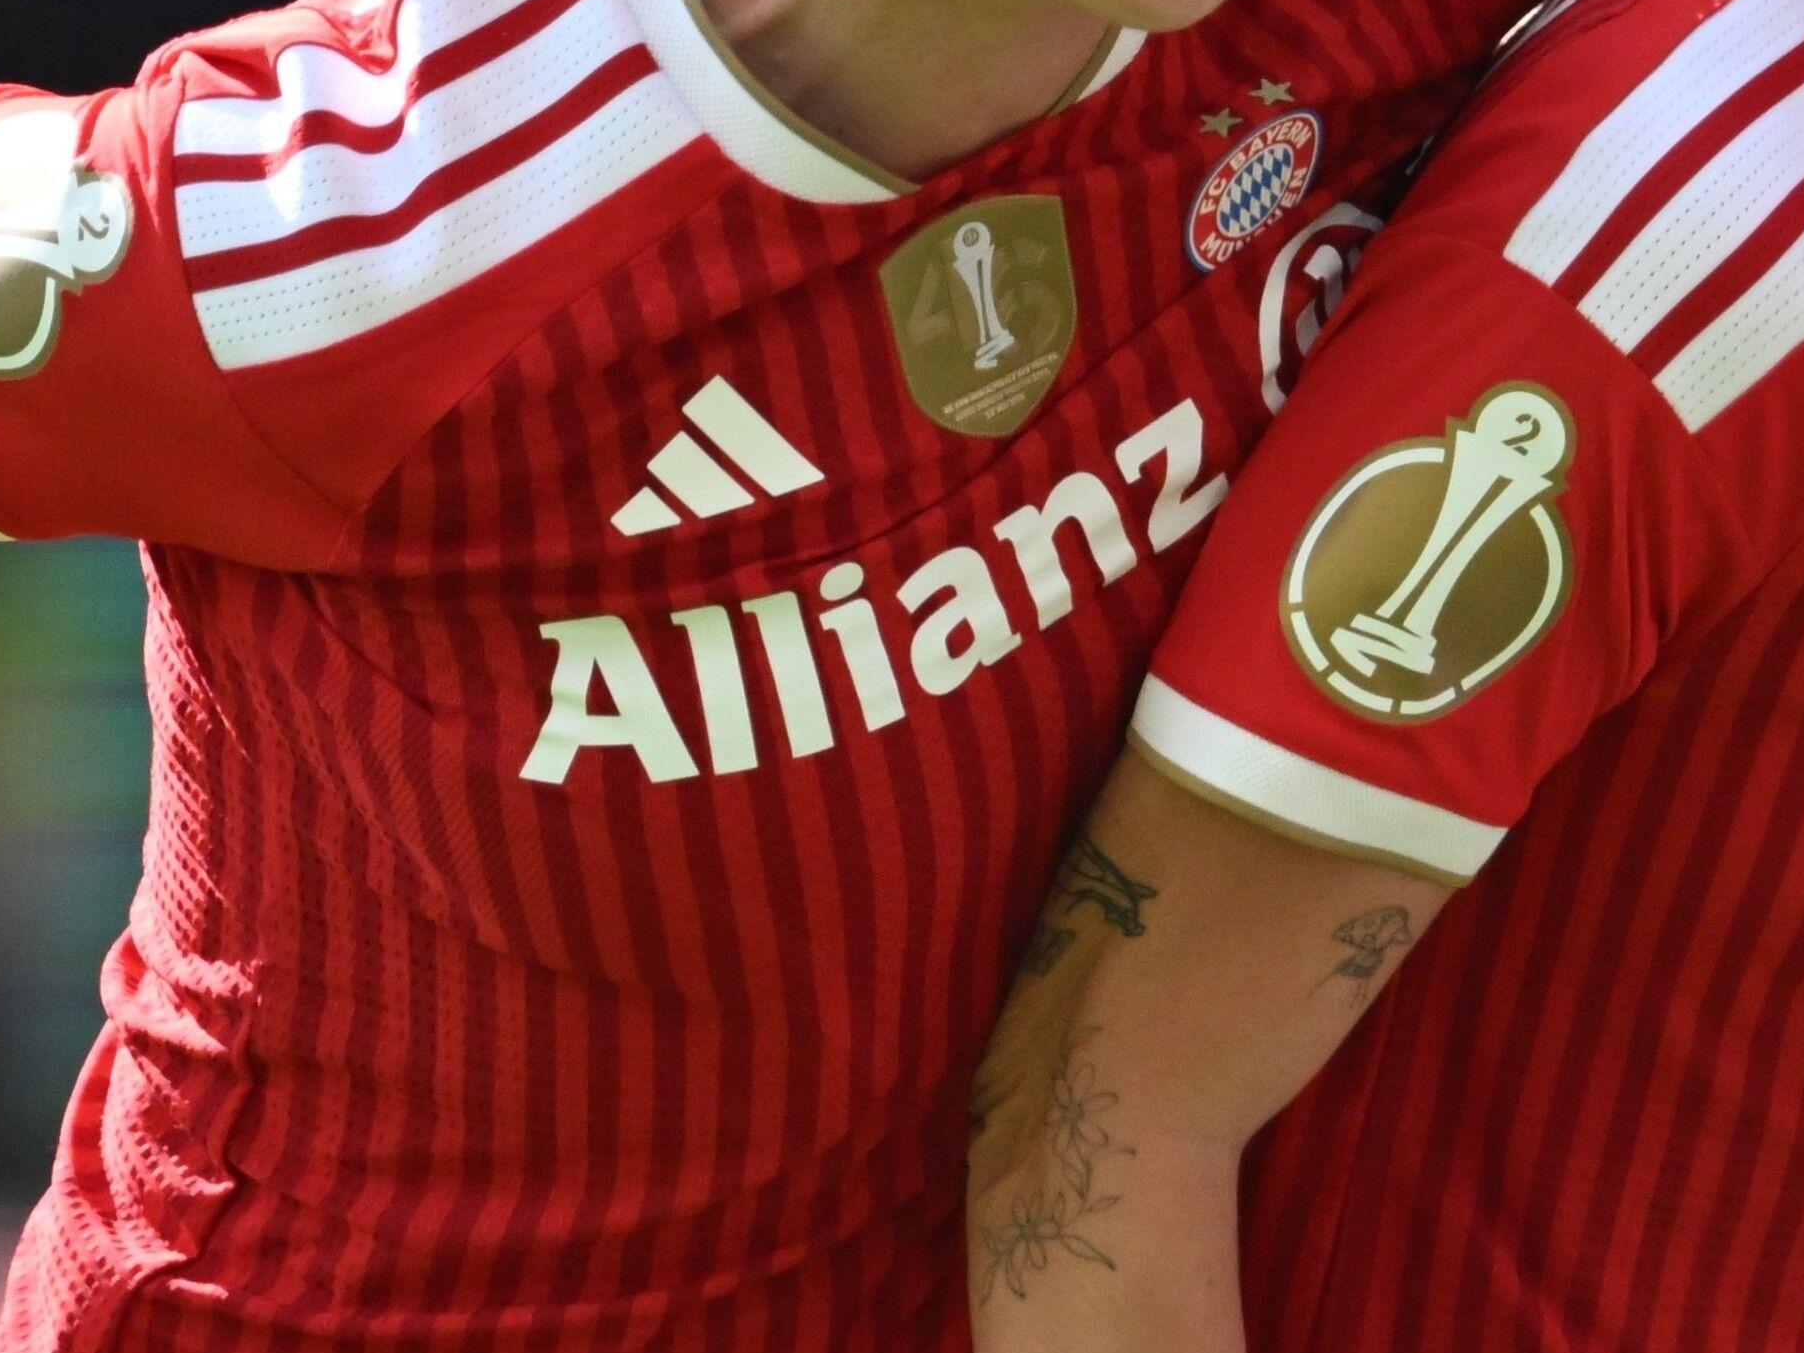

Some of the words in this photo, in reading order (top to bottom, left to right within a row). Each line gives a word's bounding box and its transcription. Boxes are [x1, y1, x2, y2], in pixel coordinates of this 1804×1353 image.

[1199, 176, 1228, 216] FC
[1229, 119, 1313, 172] BAYERN
[77, 212, 110, 242] 2
[1501, 412, 1542, 457] 2
[518, 397, 1229, 785] Allianz
